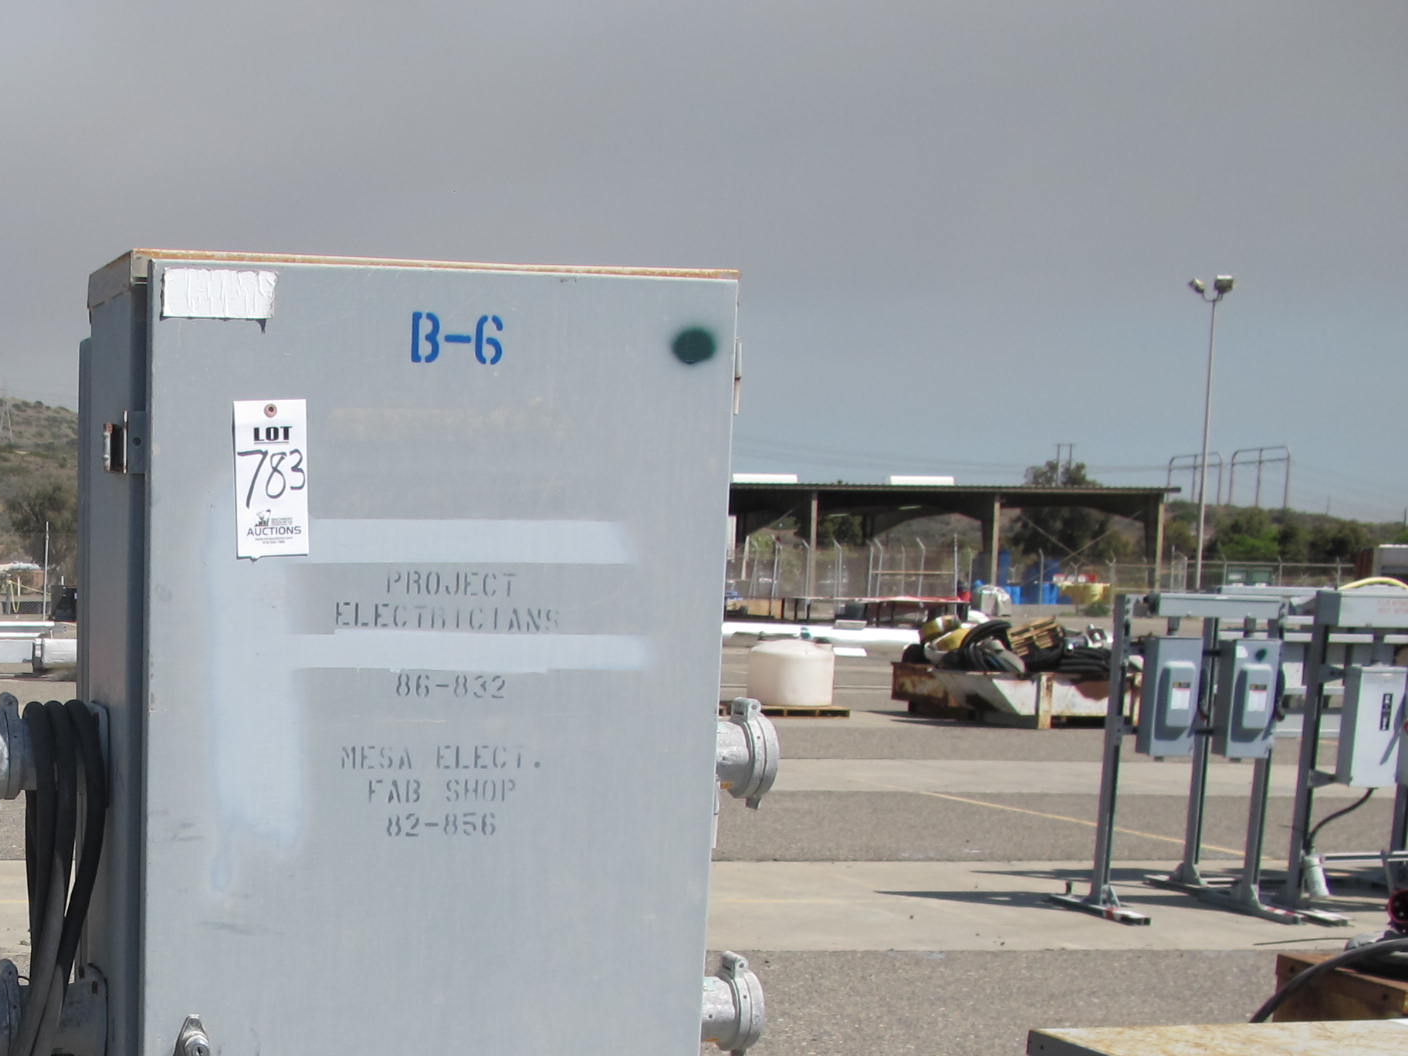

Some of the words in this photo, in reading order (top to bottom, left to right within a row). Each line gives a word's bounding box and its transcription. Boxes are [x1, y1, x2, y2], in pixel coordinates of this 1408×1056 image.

[410, 312, 504, 365] B-6
[253, 425, 293, 442] LOT
[237, 448, 306, 509] 783
[247, 525, 302, 537] AUCTIONS
[386, 571, 516, 598] PROJECT
[335, 601, 560, 633] ELECTRICIANS
[395, 673, 506, 699] 86-832
[341, 745, 413, 770] MESA
[368, 779, 422, 804] FAB
[445, 778, 516, 803] SHOP
[386, 812, 497, 838] 82-856
